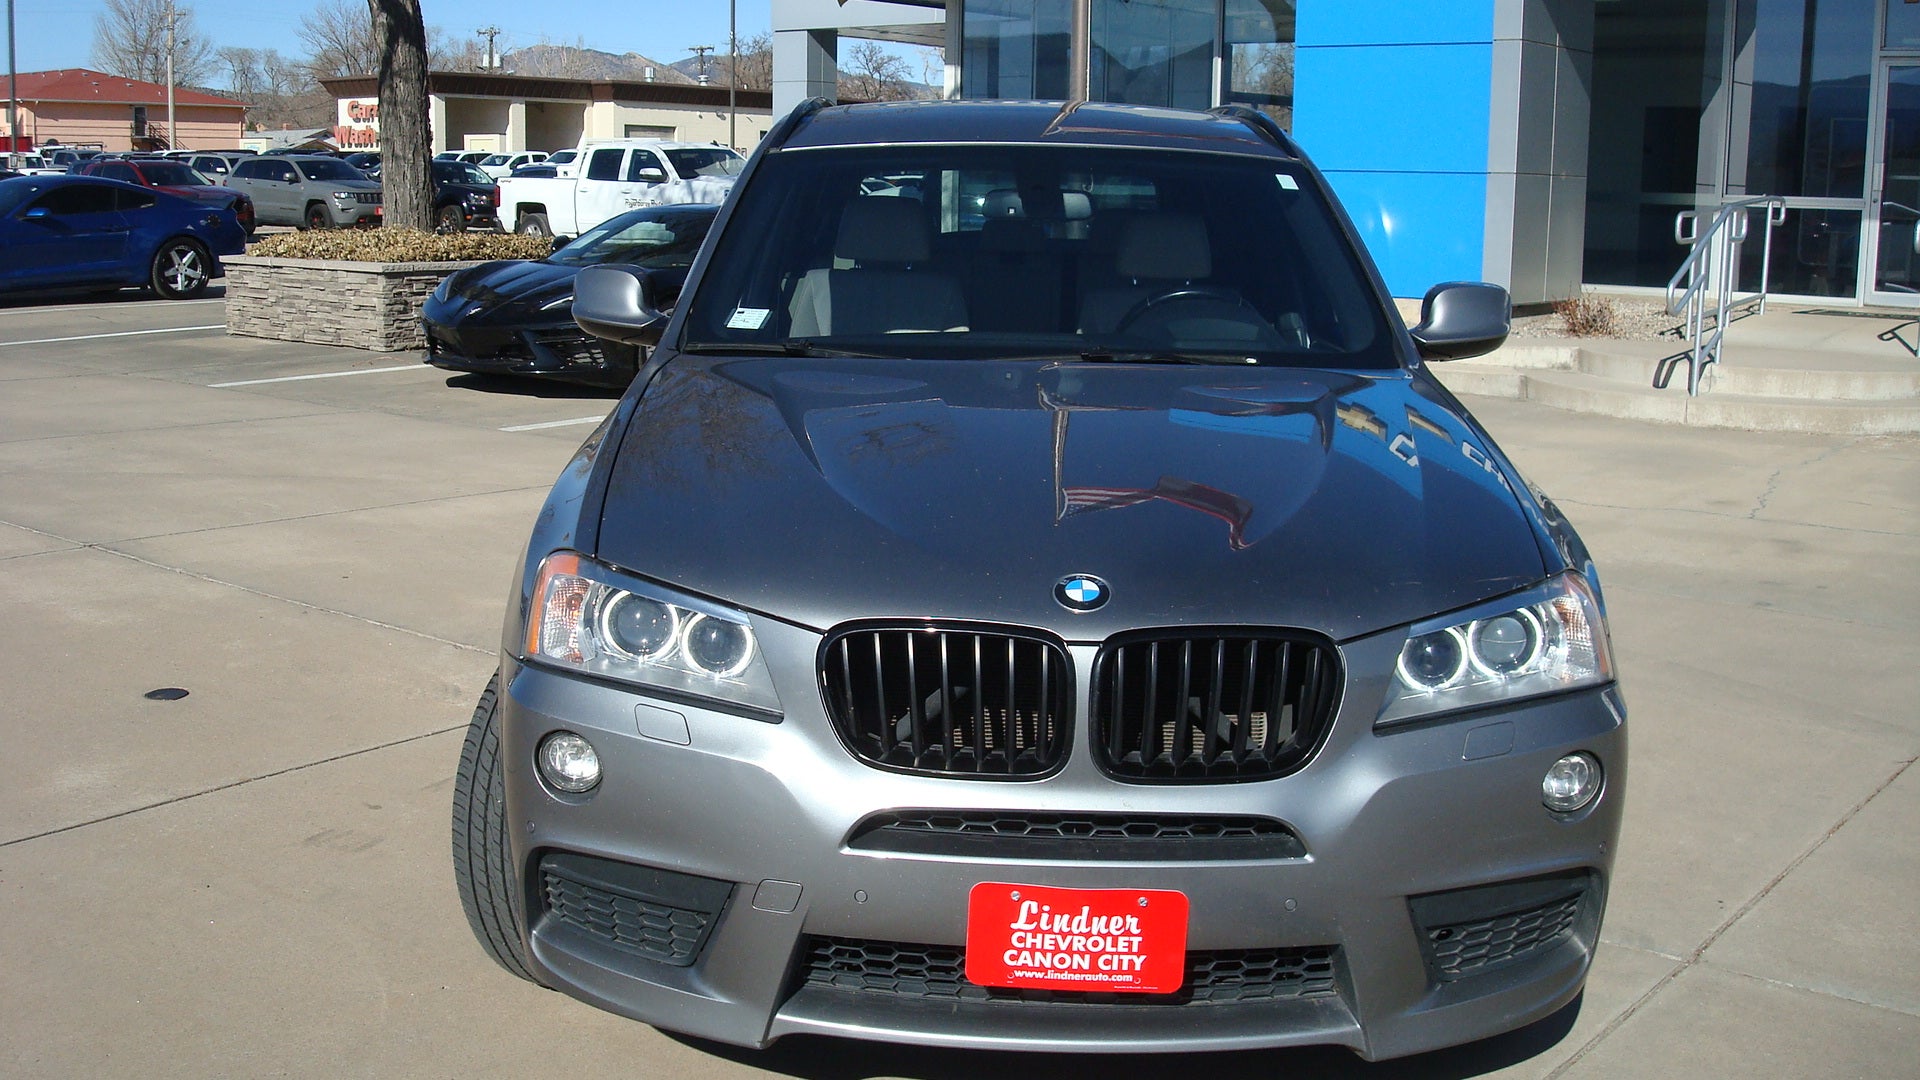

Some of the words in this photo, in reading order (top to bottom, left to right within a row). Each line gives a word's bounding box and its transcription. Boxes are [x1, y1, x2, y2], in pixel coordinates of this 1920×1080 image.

[333, 125, 376, 144] Wash
[1010, 900, 1141, 935] Lindner
[1011, 931, 1143, 952] CHEVROLET
[1003, 949, 1091, 970] CANON
[1097, 954, 1147, 971] CITY
[1014, 969, 1133, 982] www.lindnerauto.com
